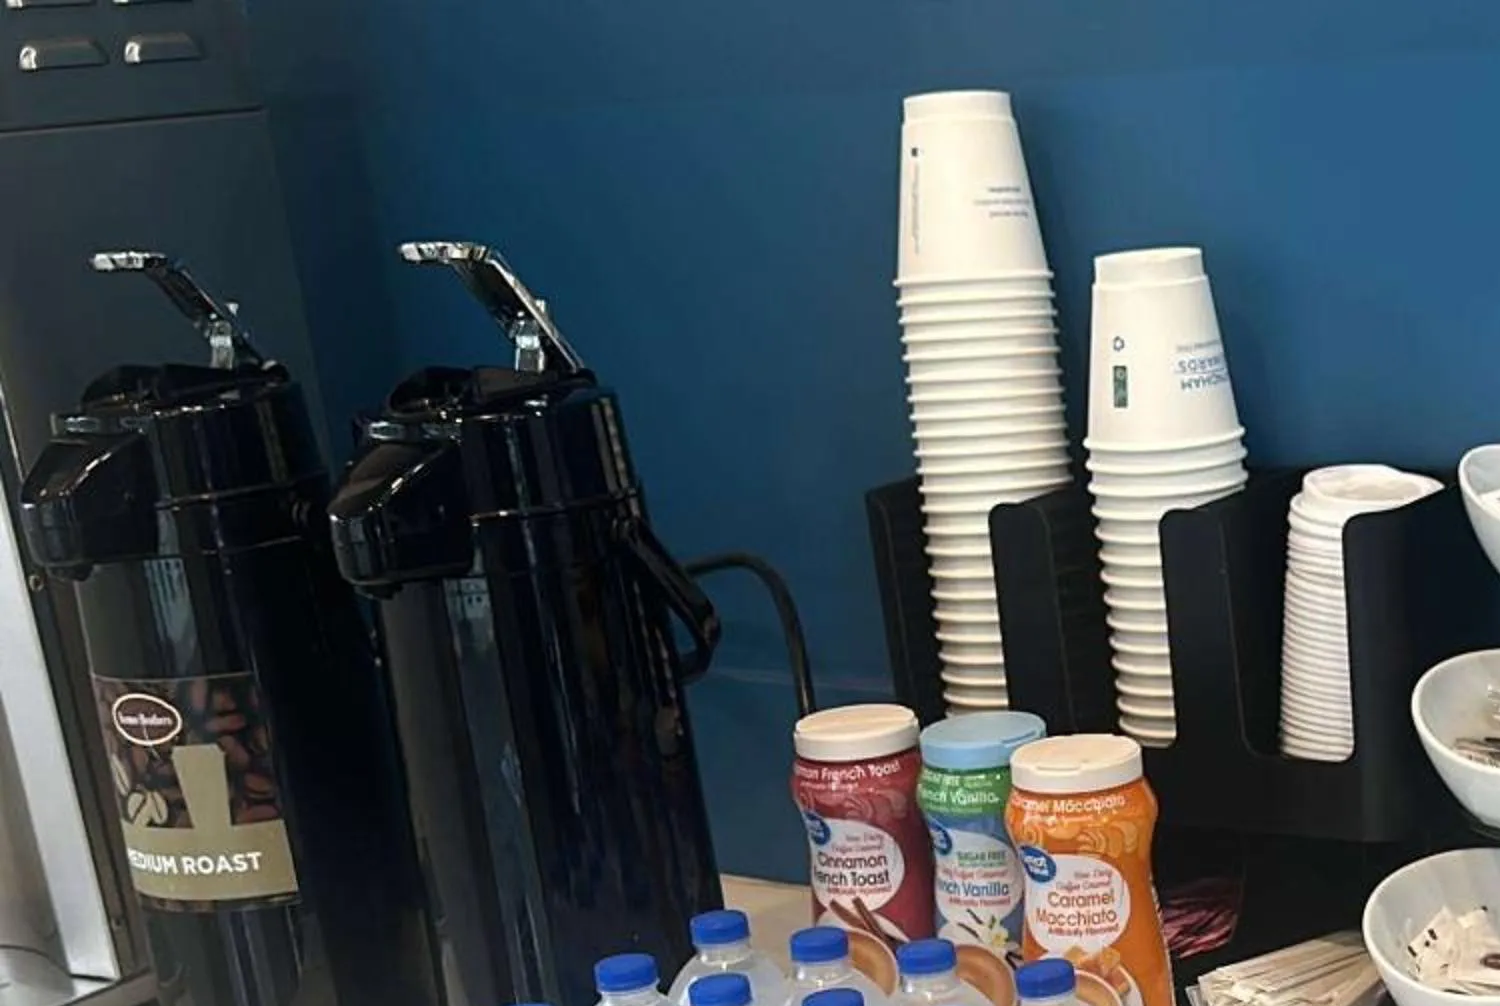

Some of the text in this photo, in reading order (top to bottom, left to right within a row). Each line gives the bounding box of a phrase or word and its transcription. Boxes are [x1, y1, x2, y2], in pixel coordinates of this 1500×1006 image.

[182, 852, 263, 875] ROAST
[1048, 887, 1115, 908] Caramel
[1036, 907, 1118, 926] Macchiato
